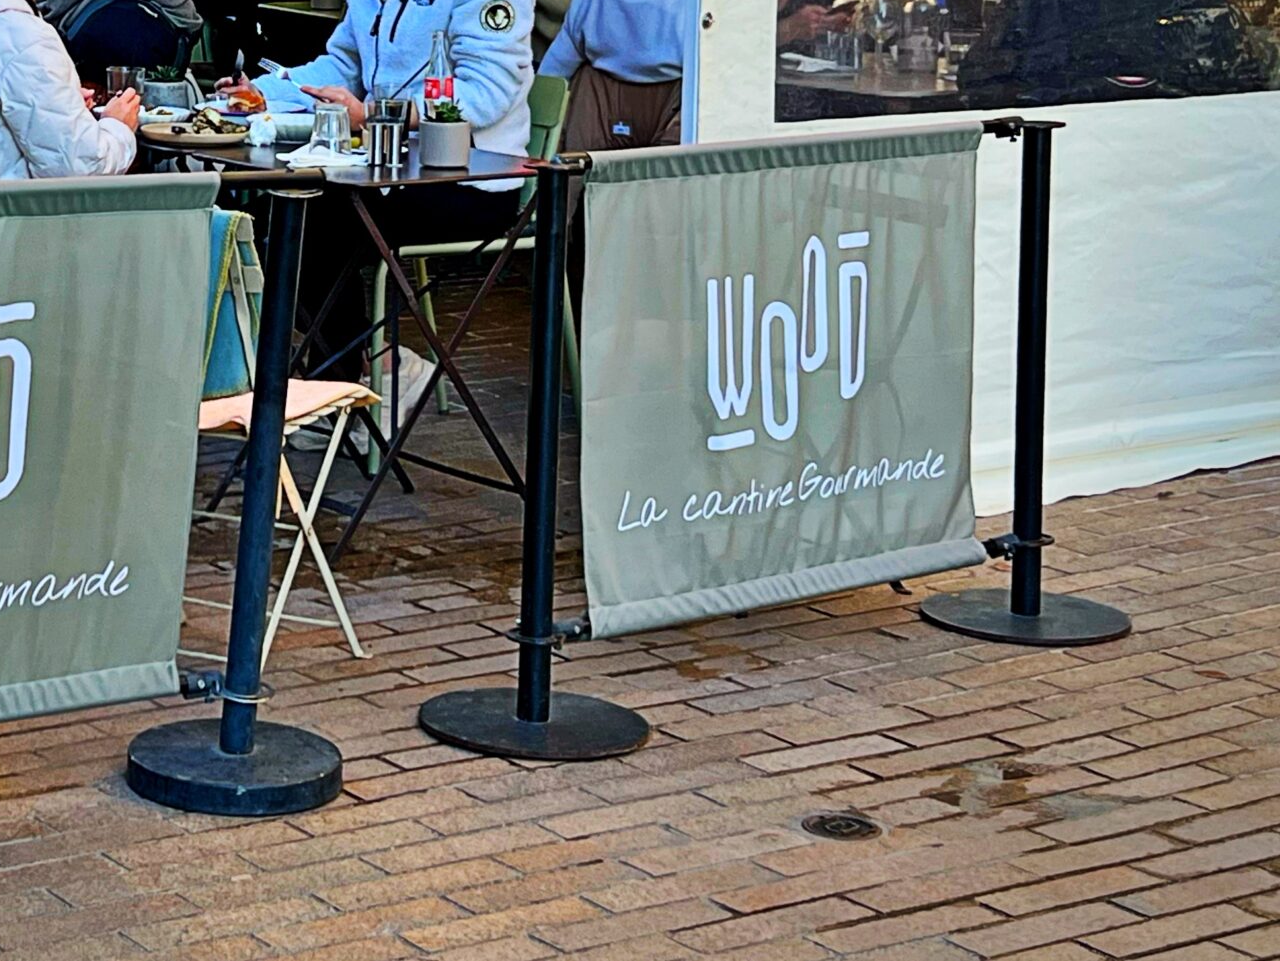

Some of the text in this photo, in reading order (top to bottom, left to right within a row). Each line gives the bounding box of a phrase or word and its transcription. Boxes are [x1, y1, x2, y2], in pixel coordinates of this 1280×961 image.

[707, 230, 870, 451] WOOD
[617, 448, 946, 532] La cantine Gourmande
